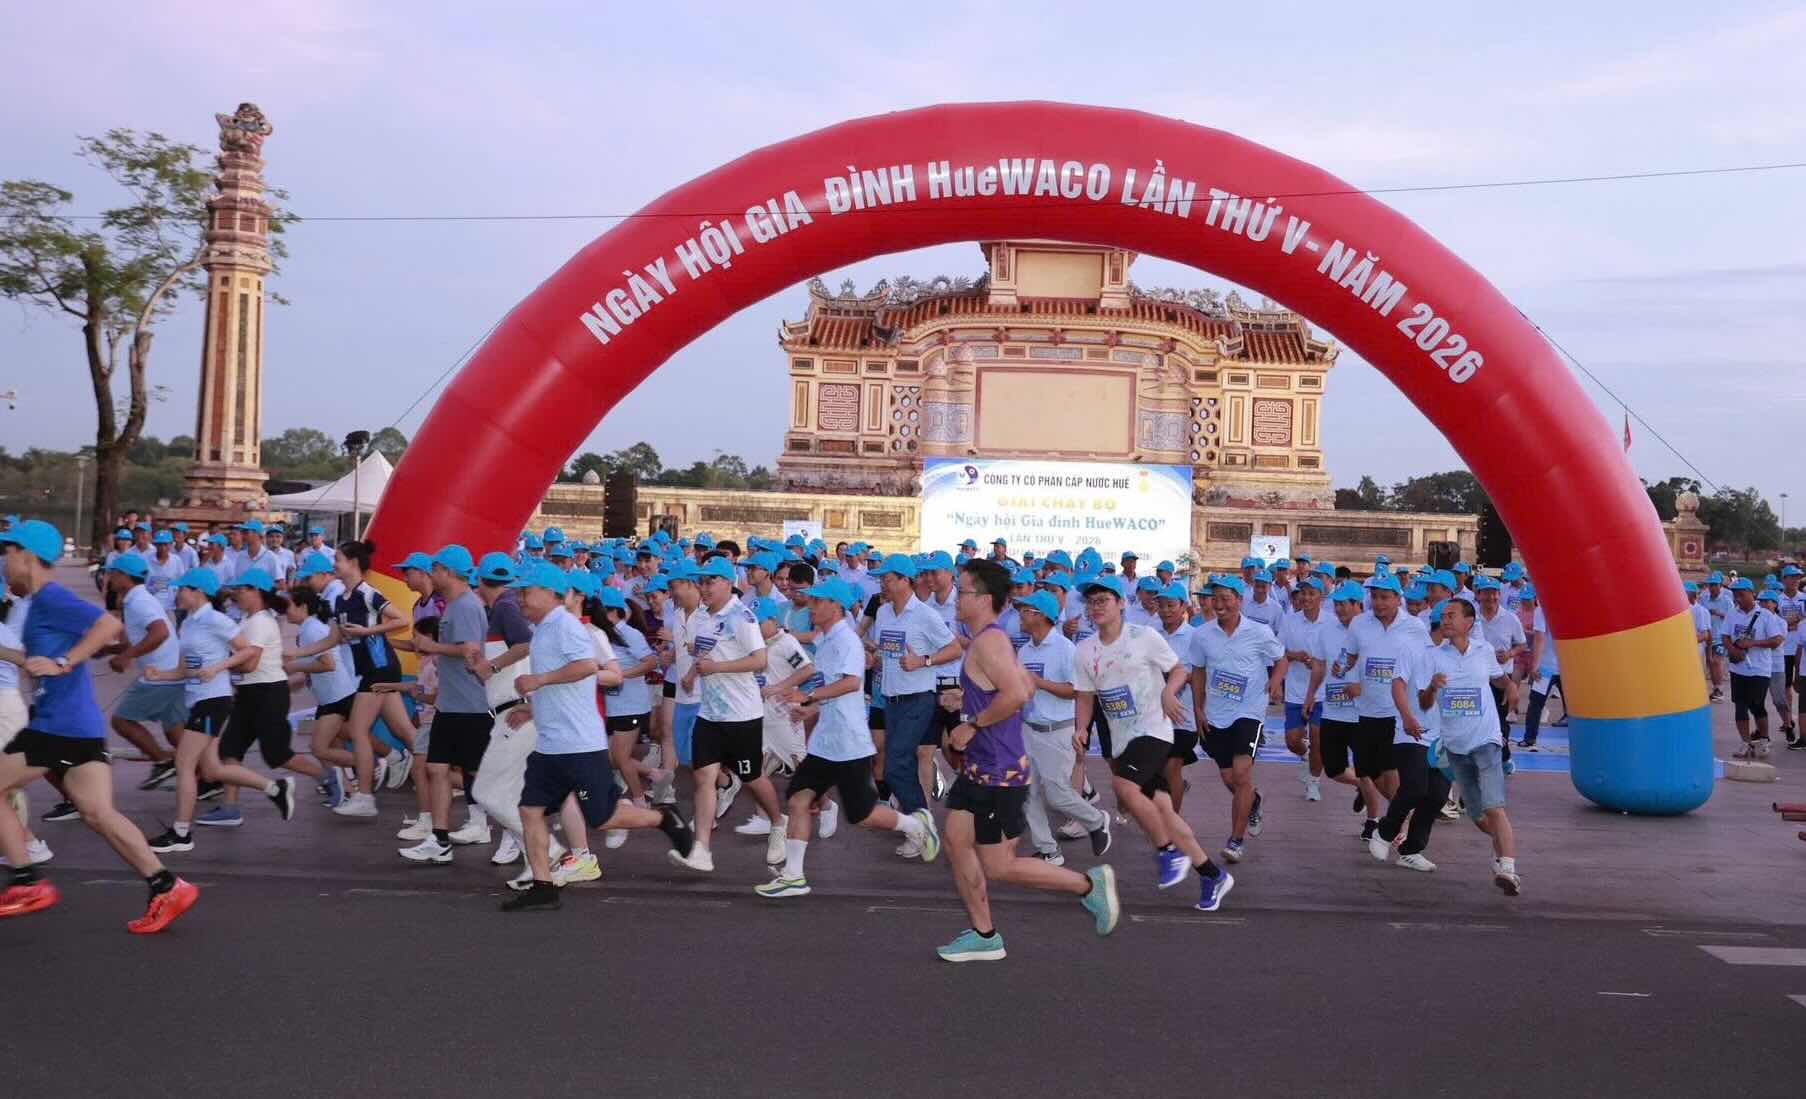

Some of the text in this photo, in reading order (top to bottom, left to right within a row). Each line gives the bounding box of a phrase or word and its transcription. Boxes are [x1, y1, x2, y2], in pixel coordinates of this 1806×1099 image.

[579, 256, 678, 345] NGÀY
[671, 220, 743, 281] HỘI
[743, 190, 814, 245] GIA
[823, 164, 918, 216] ĐÌNH
[922, 158, 1112, 201] HueWACO
[1120, 159, 1198, 219] LẦN
[1205, 187, 1284, 243] THỨ
[1316, 239, 1408, 317] NĂM
[1396, 303, 1485, 384] 2026
[1011, 474, 1021, 486] TY
[736, 759, 751, 775] 13
